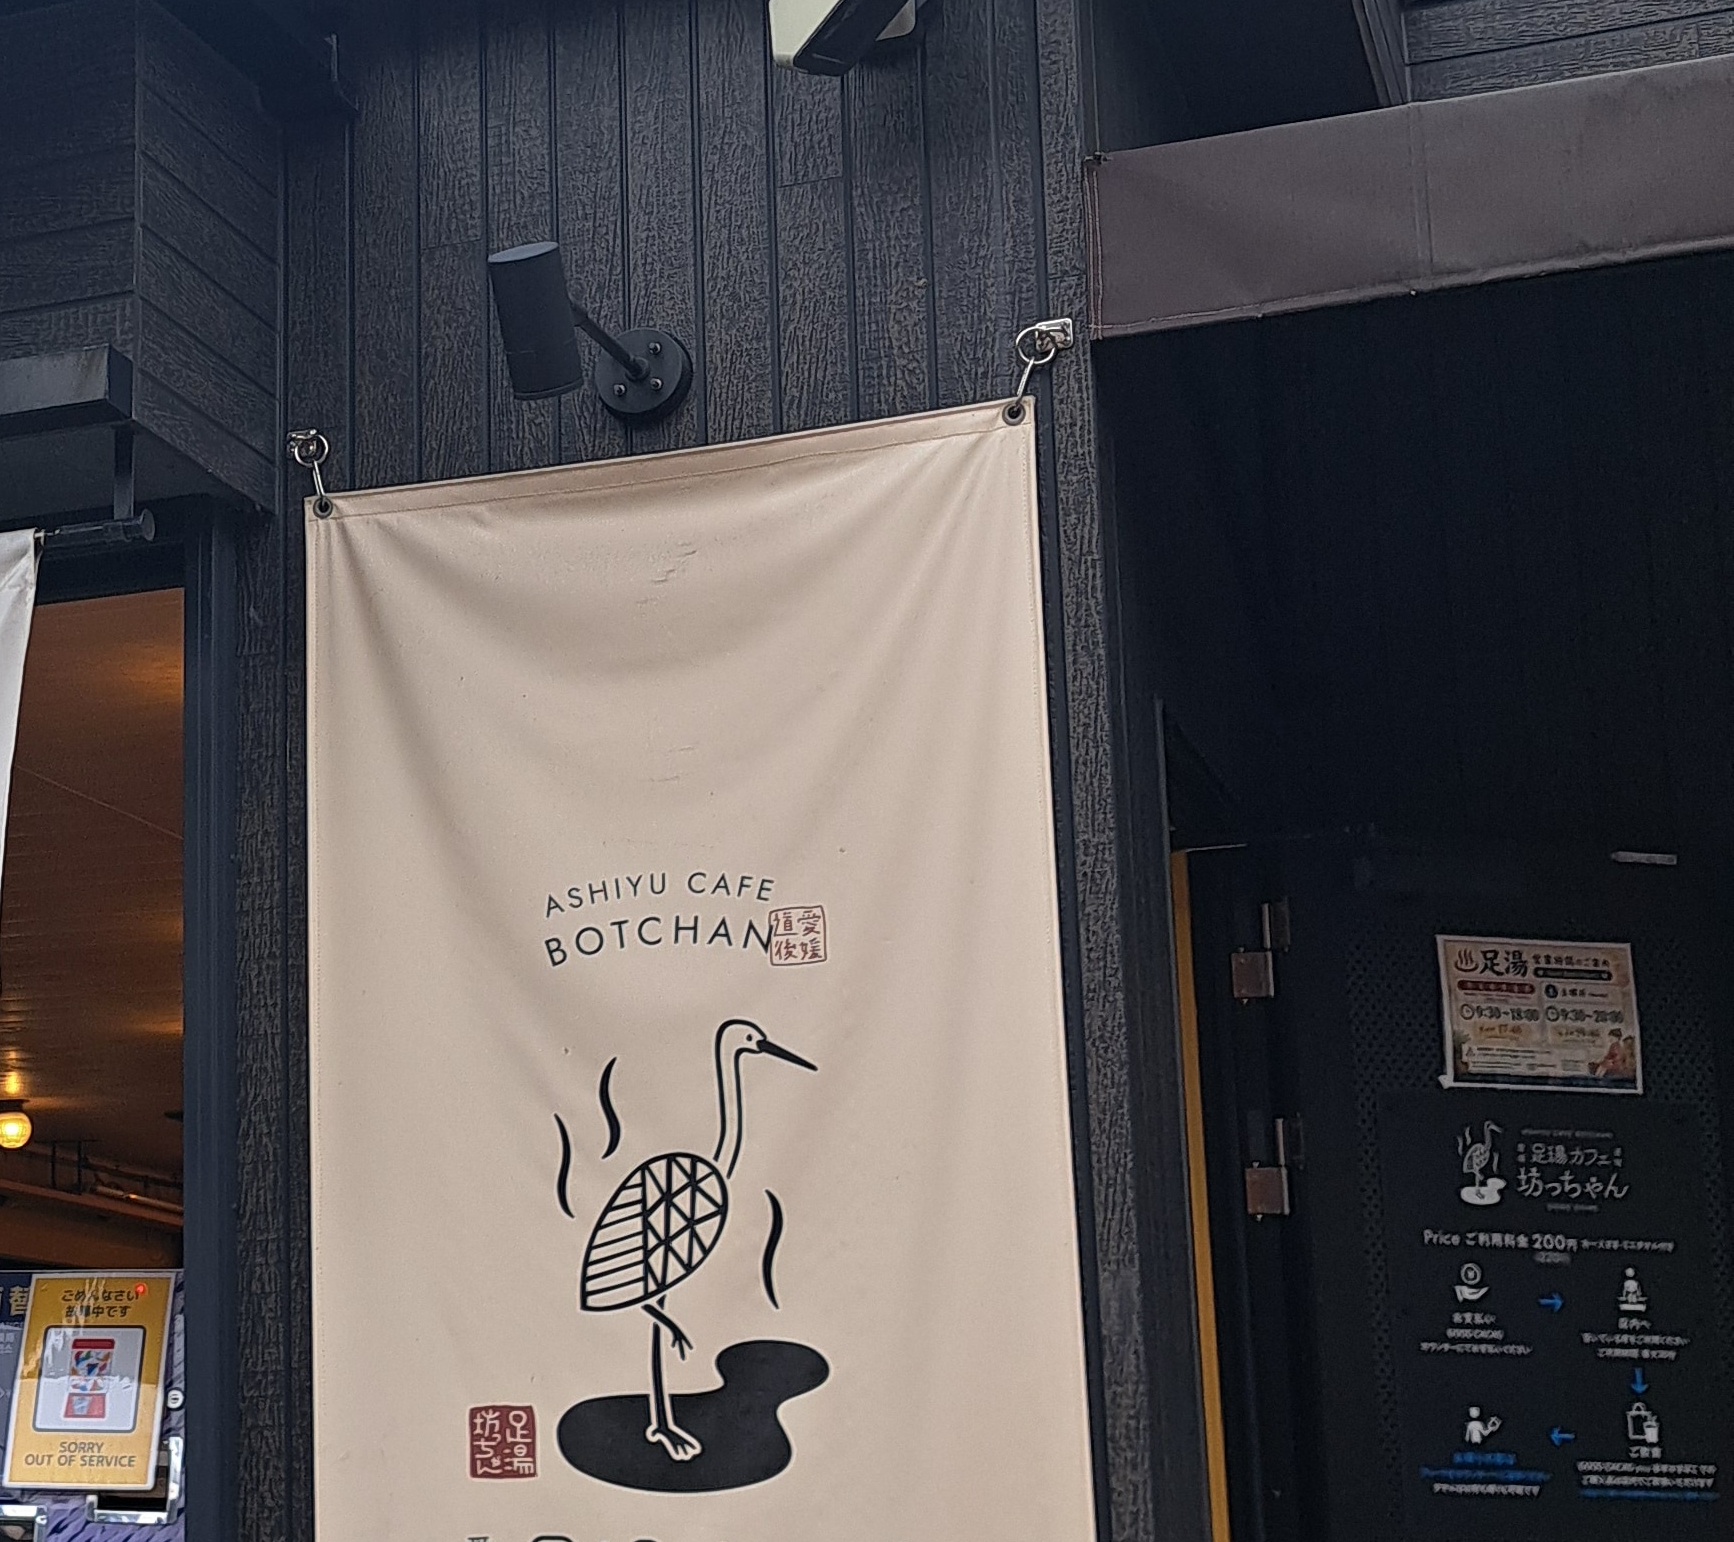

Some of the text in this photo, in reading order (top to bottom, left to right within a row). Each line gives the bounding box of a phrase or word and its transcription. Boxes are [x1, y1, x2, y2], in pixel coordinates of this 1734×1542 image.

[545, 871, 775, 919] ASHIYU CAFE
[544, 914, 774, 967] BOTCHAN
[1480, 949, 1528, 978] 足湯
[1517, 1167, 1631, 1200] 坊っちゃん
[1423, 1228, 1461, 1247] Price
[61, 1288, 140, 1302] ごめんなさい
[58, 1441, 105, 1454] SORRY
[24, 1453, 137, 1468] OUT OF SERVICE
